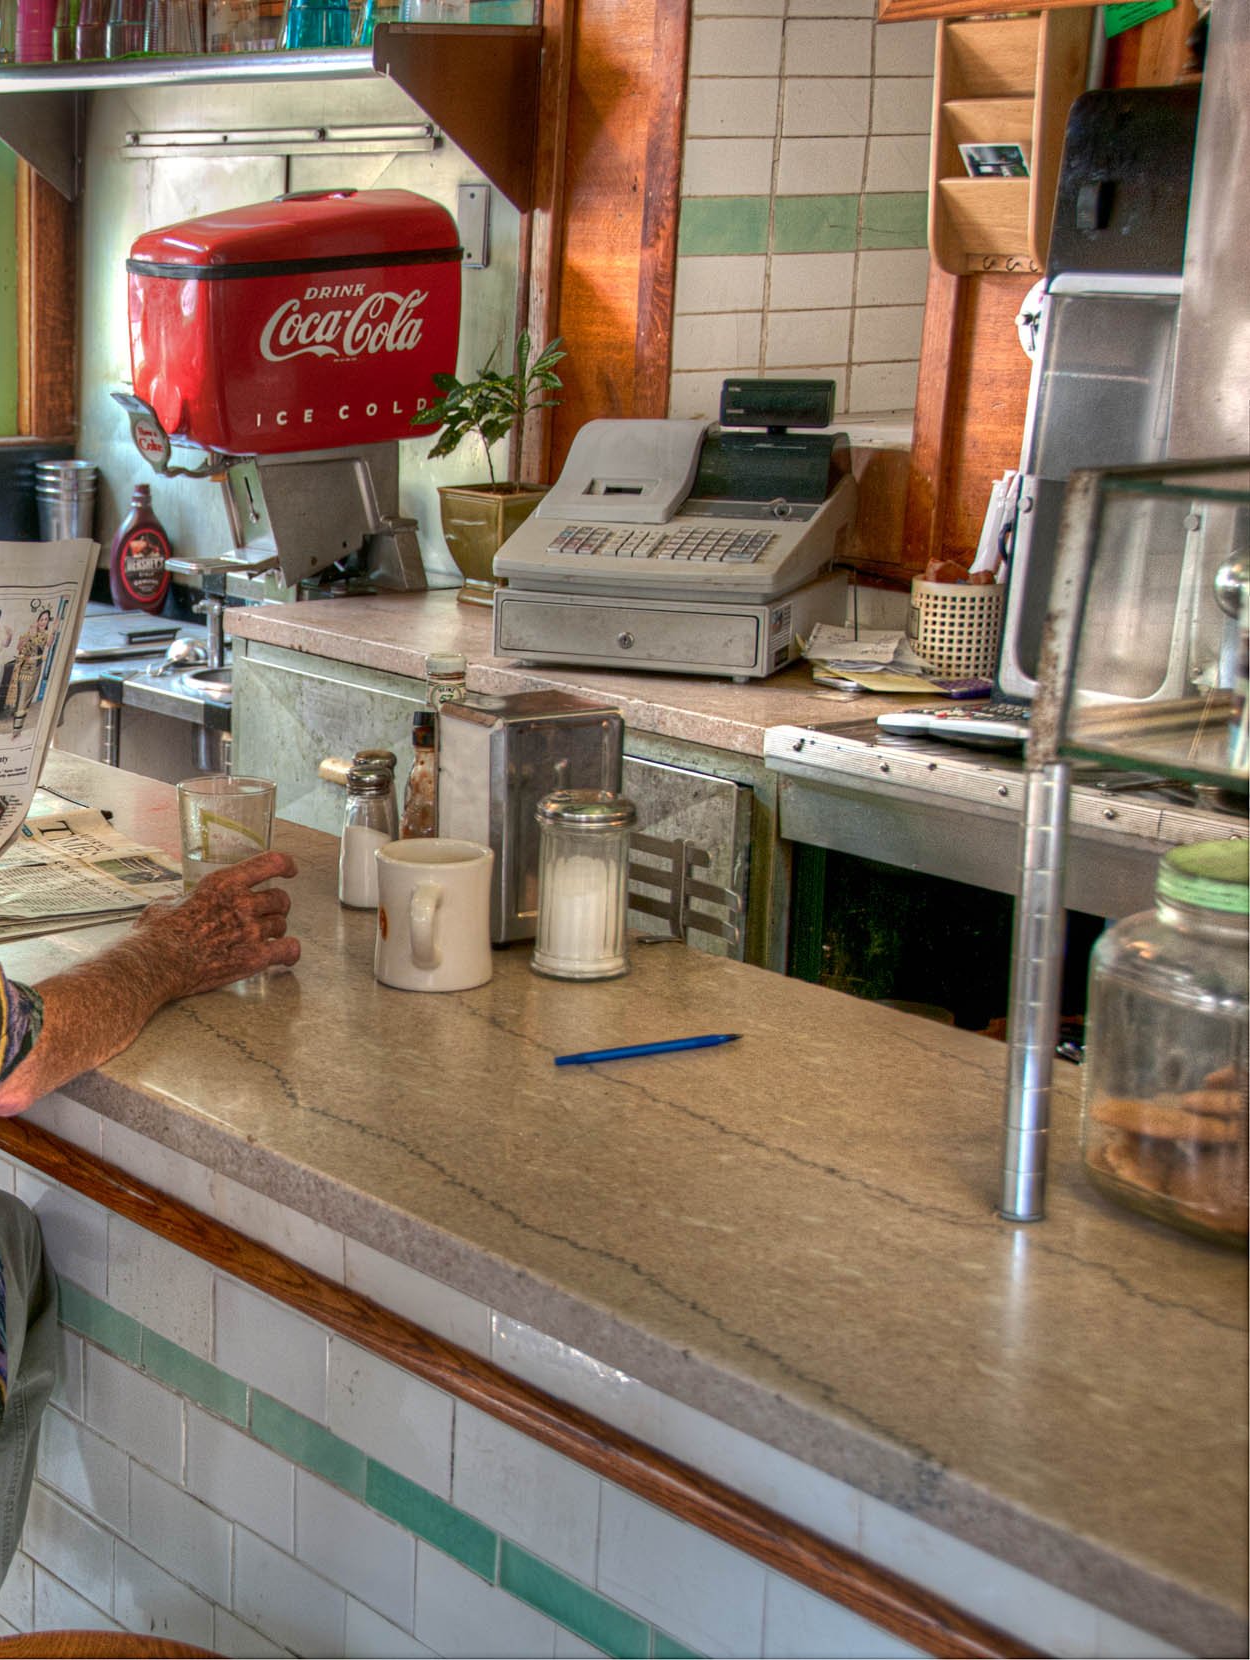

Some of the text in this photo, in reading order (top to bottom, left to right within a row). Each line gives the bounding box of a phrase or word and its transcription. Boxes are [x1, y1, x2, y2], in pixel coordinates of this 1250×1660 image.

[304, 284, 366, 301] DRINK
[259, 289, 430, 362] Coca-Cola
[255, 398, 427, 427] ICE COLD
